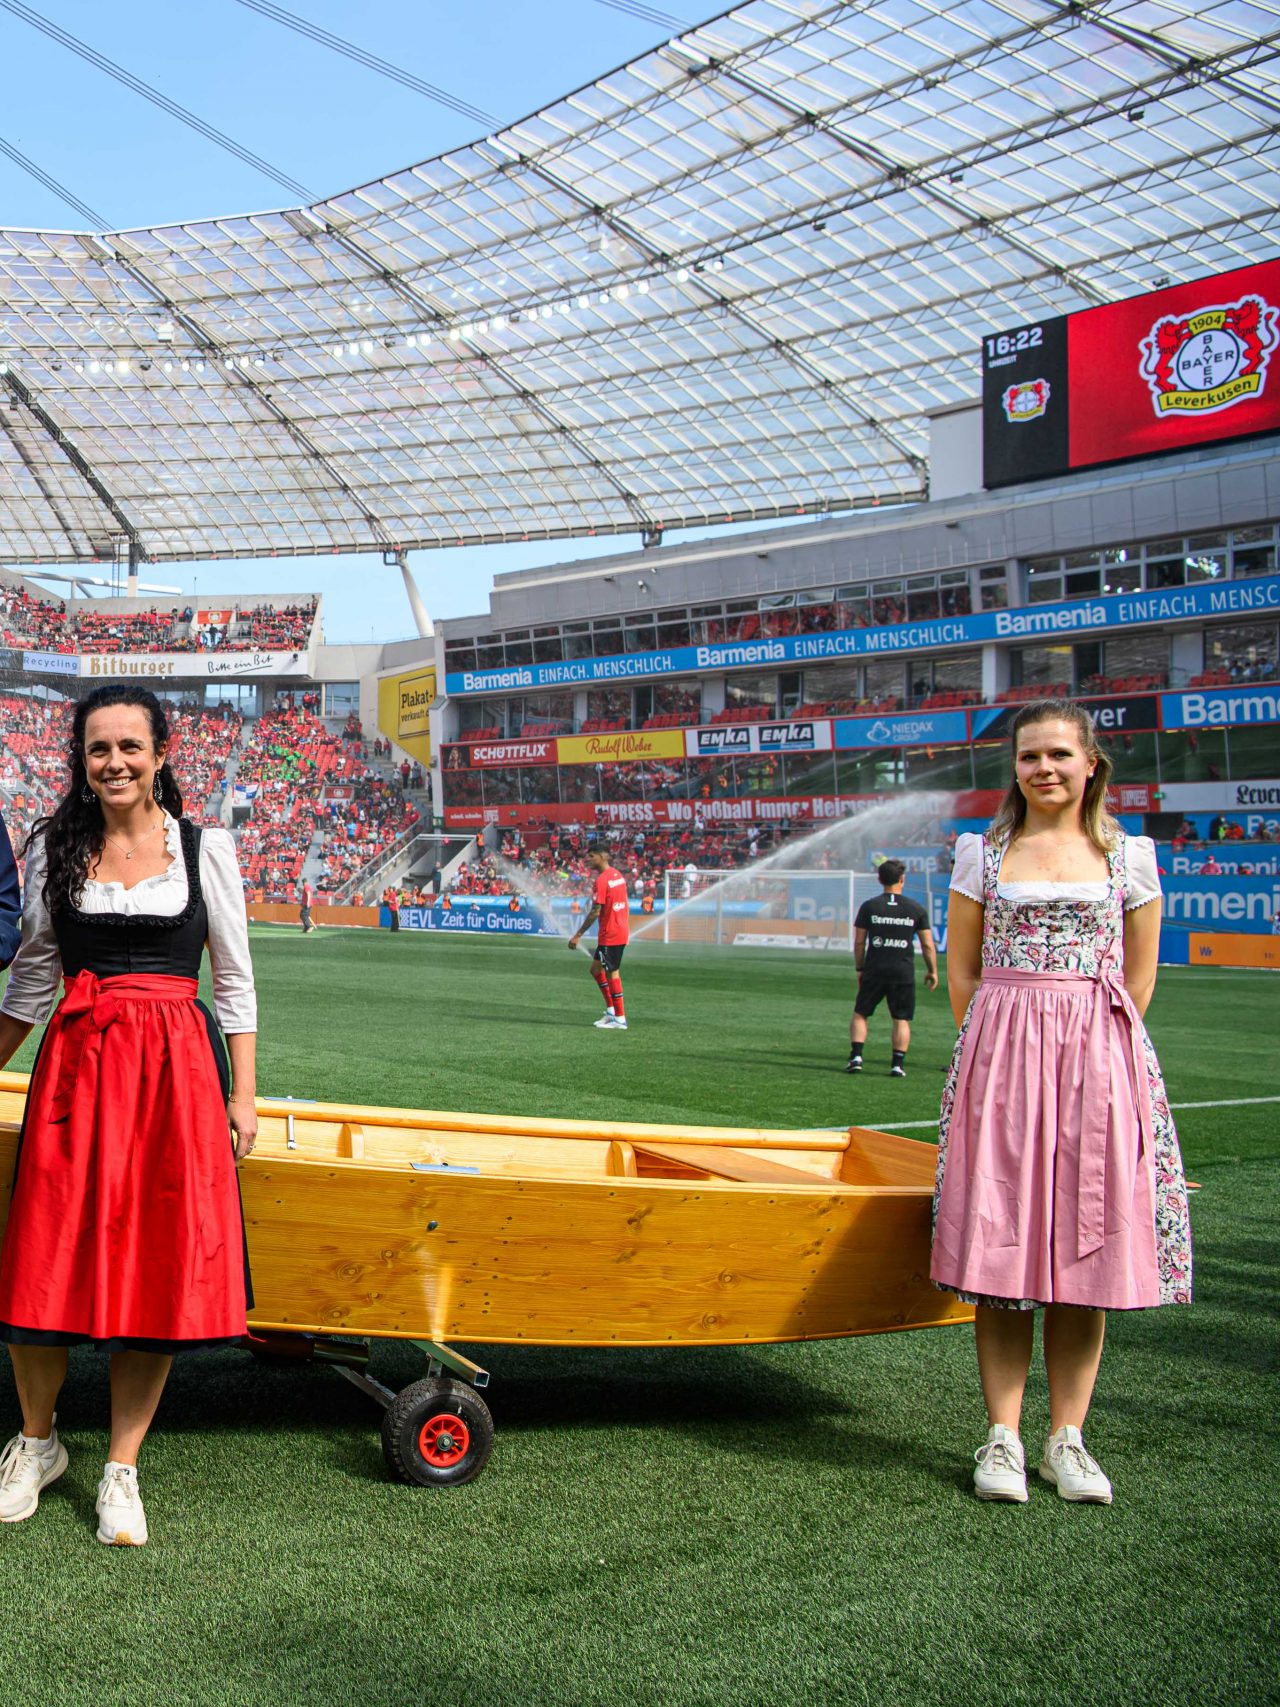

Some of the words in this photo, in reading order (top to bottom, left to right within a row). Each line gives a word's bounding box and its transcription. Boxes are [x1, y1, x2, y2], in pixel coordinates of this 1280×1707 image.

[1191, 315, 1222, 331] 1904
[986, 327, 1043, 357] 16:22
[1181, 350, 1235, 370] BAYER
[1202, 334, 1213, 387] BAYER
[1166, 379, 1252, 407] Leverkusen
[463, 667, 533, 691] Barmenia
[539, 664, 590, 683] EINFACH.
[593, 656, 676, 677] MENSCHLICH.
[697, 639, 785, 667] Barmenia
[794, 636, 861, 658] EINFACH.
[865, 623, 969, 650] MENSCHLICH.
[995, 602, 1107, 635] Barmenia
[1119, 594, 1203, 622] EINFACH.
[23, 655, 79, 671] Recycling
[89, 656, 175, 676] Bitburger
[401, 689, 433, 709] Plakat-
[892, 721, 934, 733] NIEDAX
[585, 737, 622, 759] Rudolf
[621, 735, 653, 753] Weber
[667, 801, 692, 820] Wo
[409, 909, 437, 929] EVL
[441, 911, 465, 928] Zeit
[466, 911, 485, 929] für
[486, 912, 533, 930] Grünes
[871, 915, 915, 927] Barmenia
[883, 938, 908, 949] JAKO
